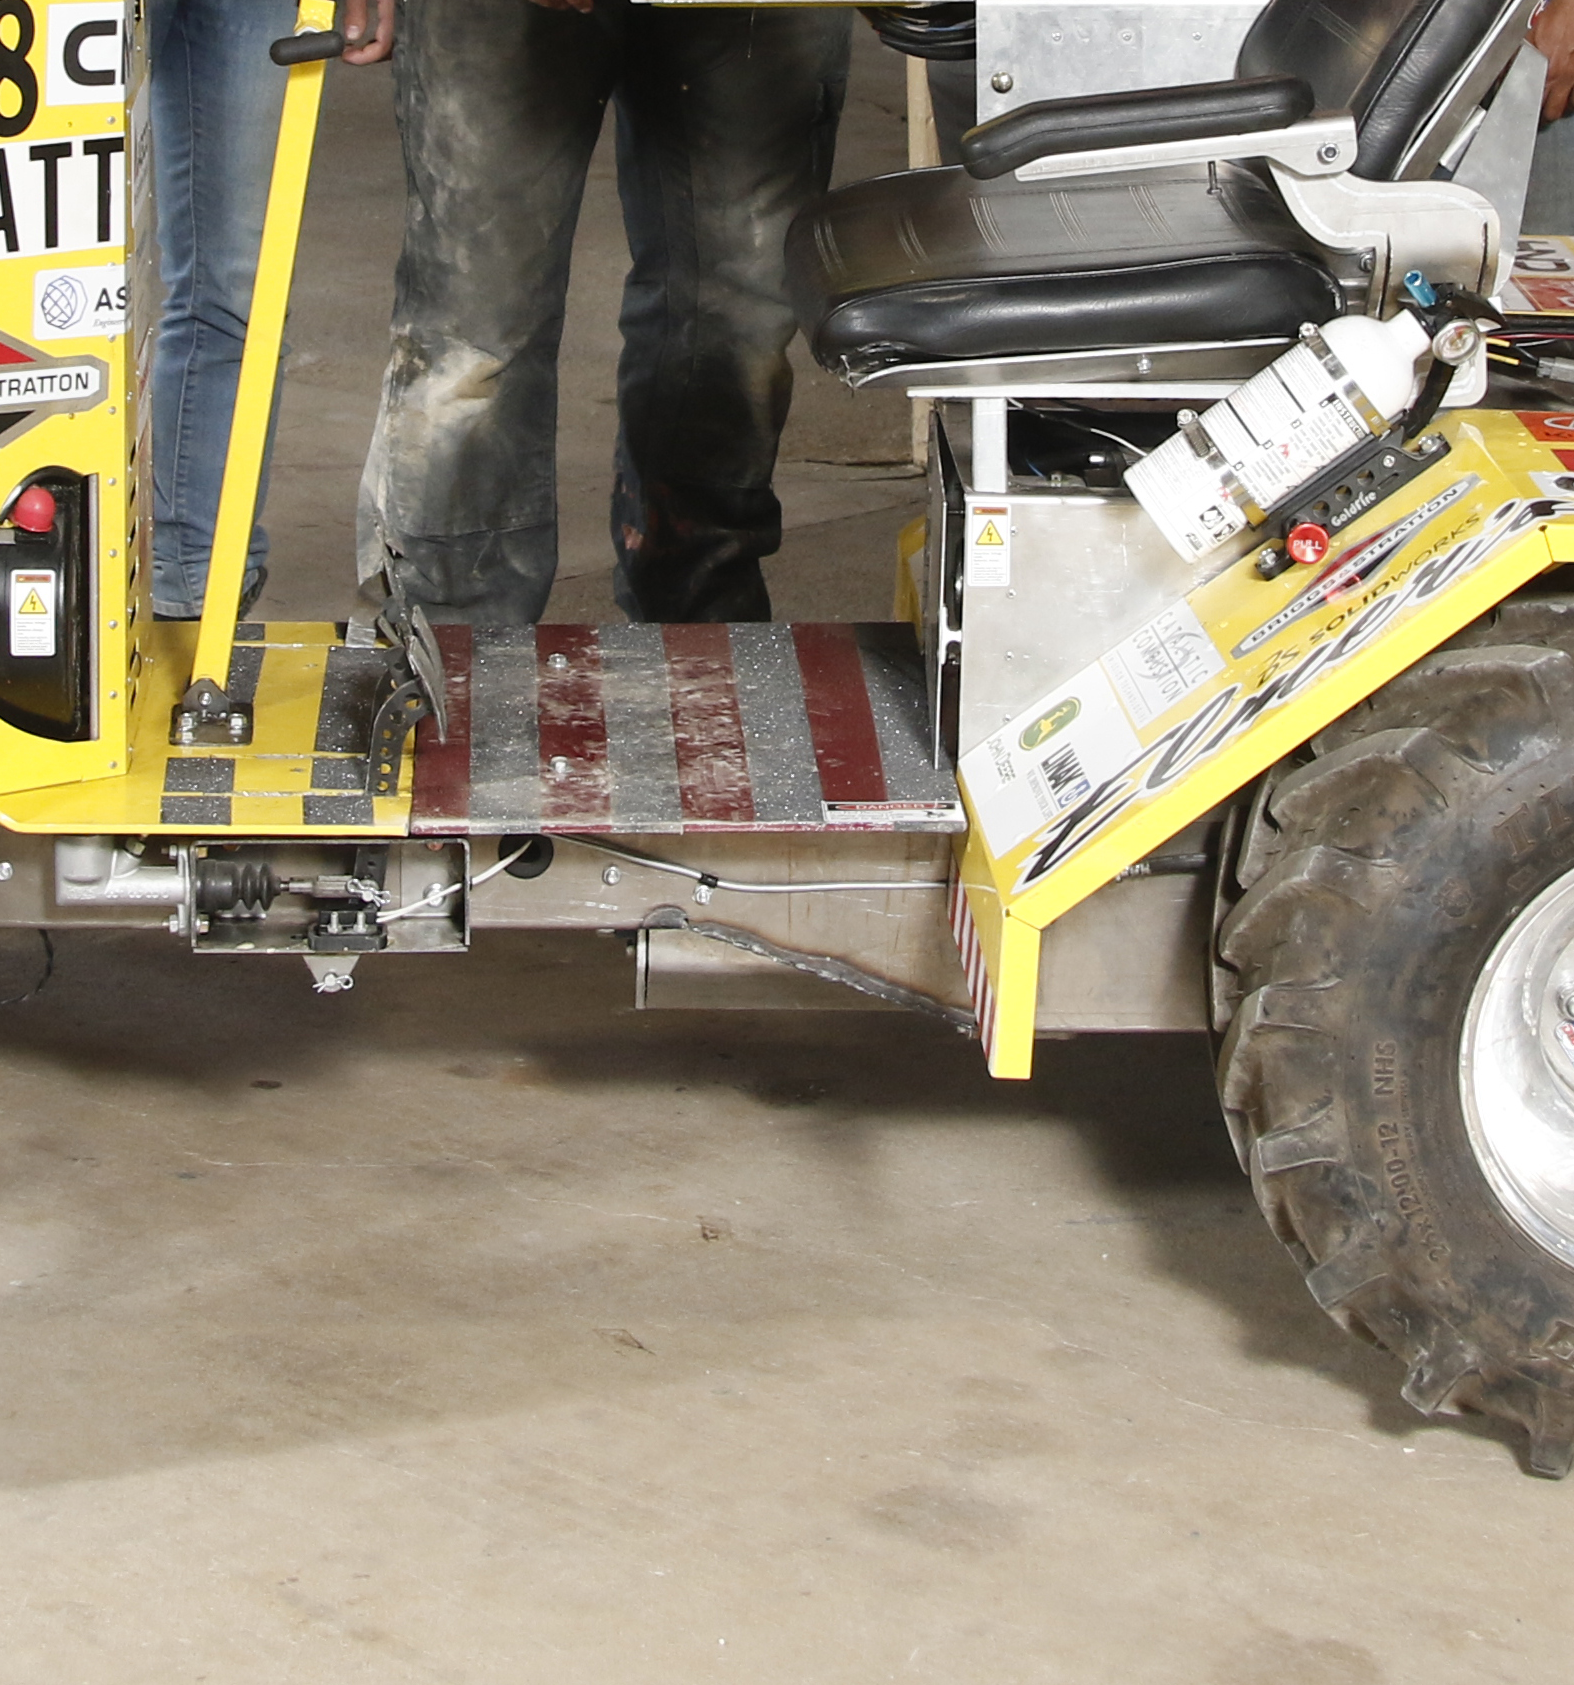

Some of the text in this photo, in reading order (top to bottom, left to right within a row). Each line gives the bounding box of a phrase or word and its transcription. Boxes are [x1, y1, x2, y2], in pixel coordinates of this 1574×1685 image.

[1331, 491, 1377, 528] Goldfire
[1352, 488, 1459, 569] STRATTON
[1293, 539, 1322, 551] PULL
[1309, 513, 1481, 644] SOLIDWORKS
[985, 731, 1019, 786] JOHN DEERE
[1039, 741, 1085, 796] LINAK
